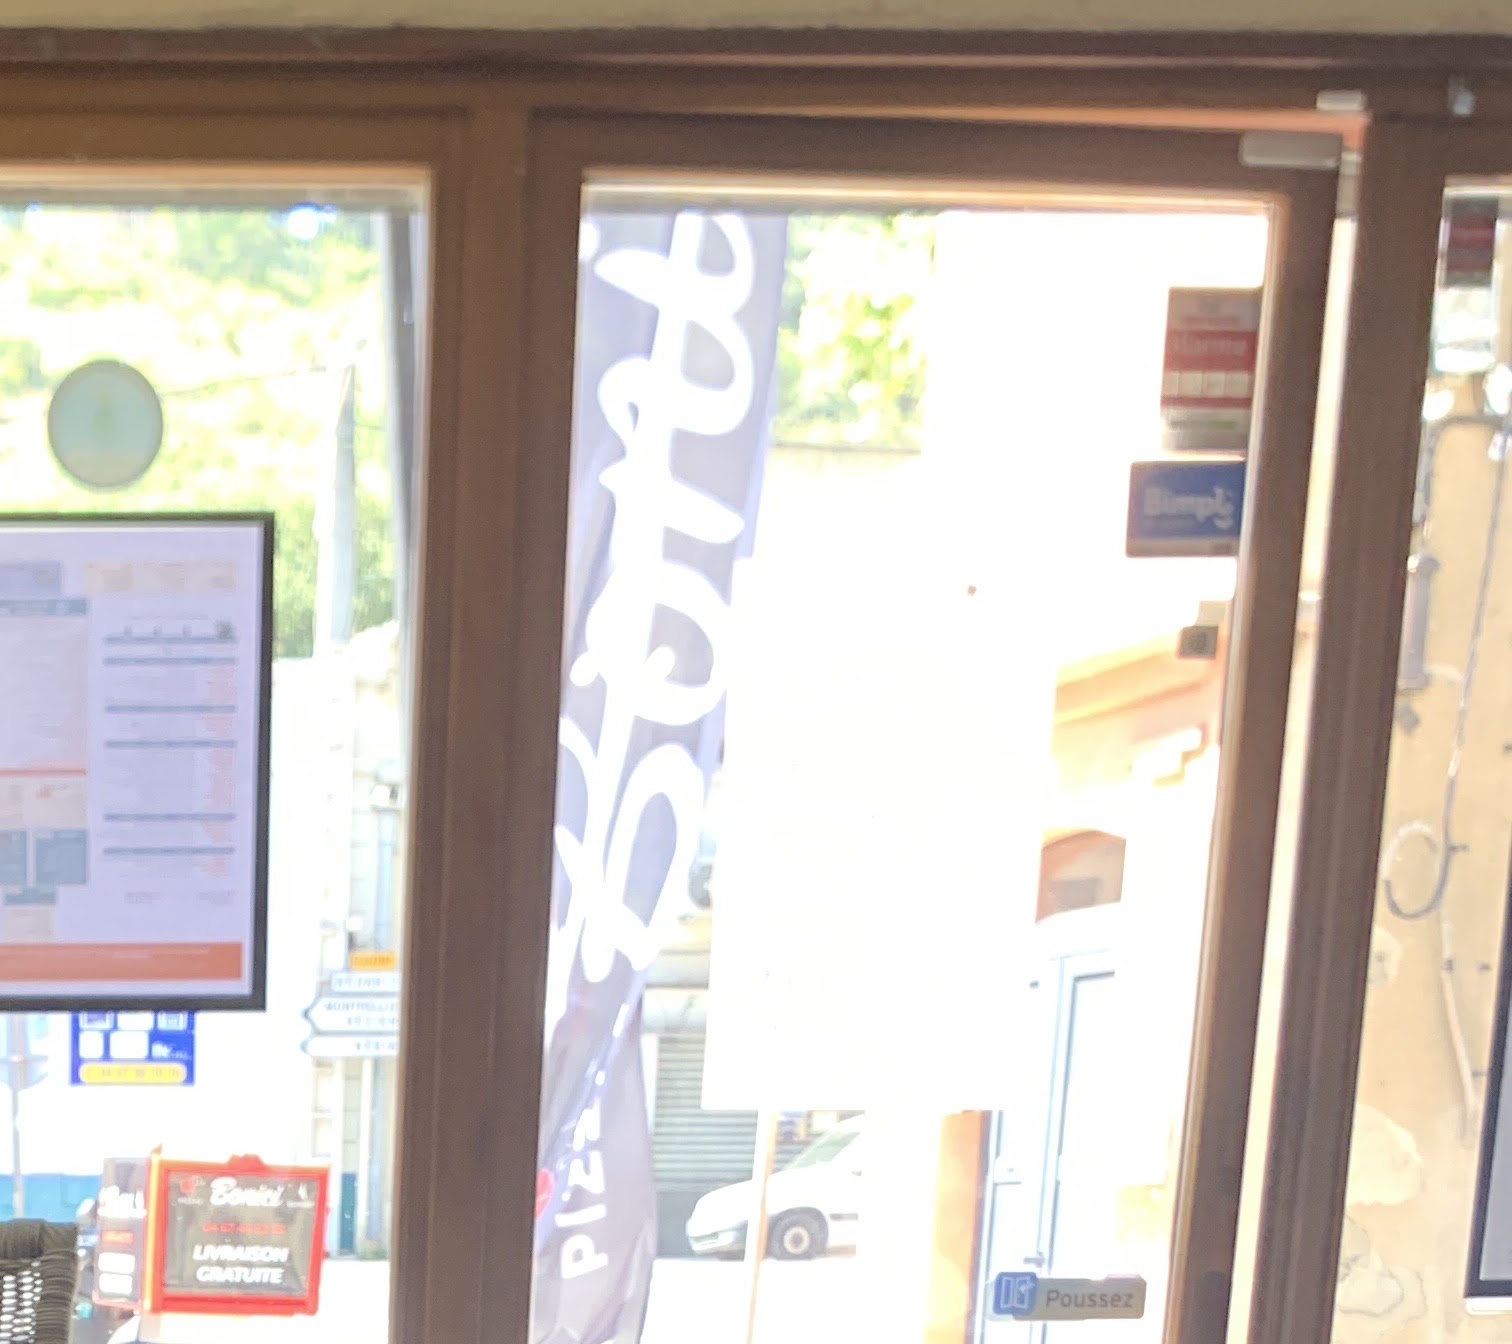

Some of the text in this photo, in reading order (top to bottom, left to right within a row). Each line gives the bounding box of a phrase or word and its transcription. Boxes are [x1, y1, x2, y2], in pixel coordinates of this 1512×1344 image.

[192, 1244, 288, 1263] LIVRAISON
[195, 1265, 285, 1284] GRATUITE
[1044, 1288, 1135, 1309] Poussez
